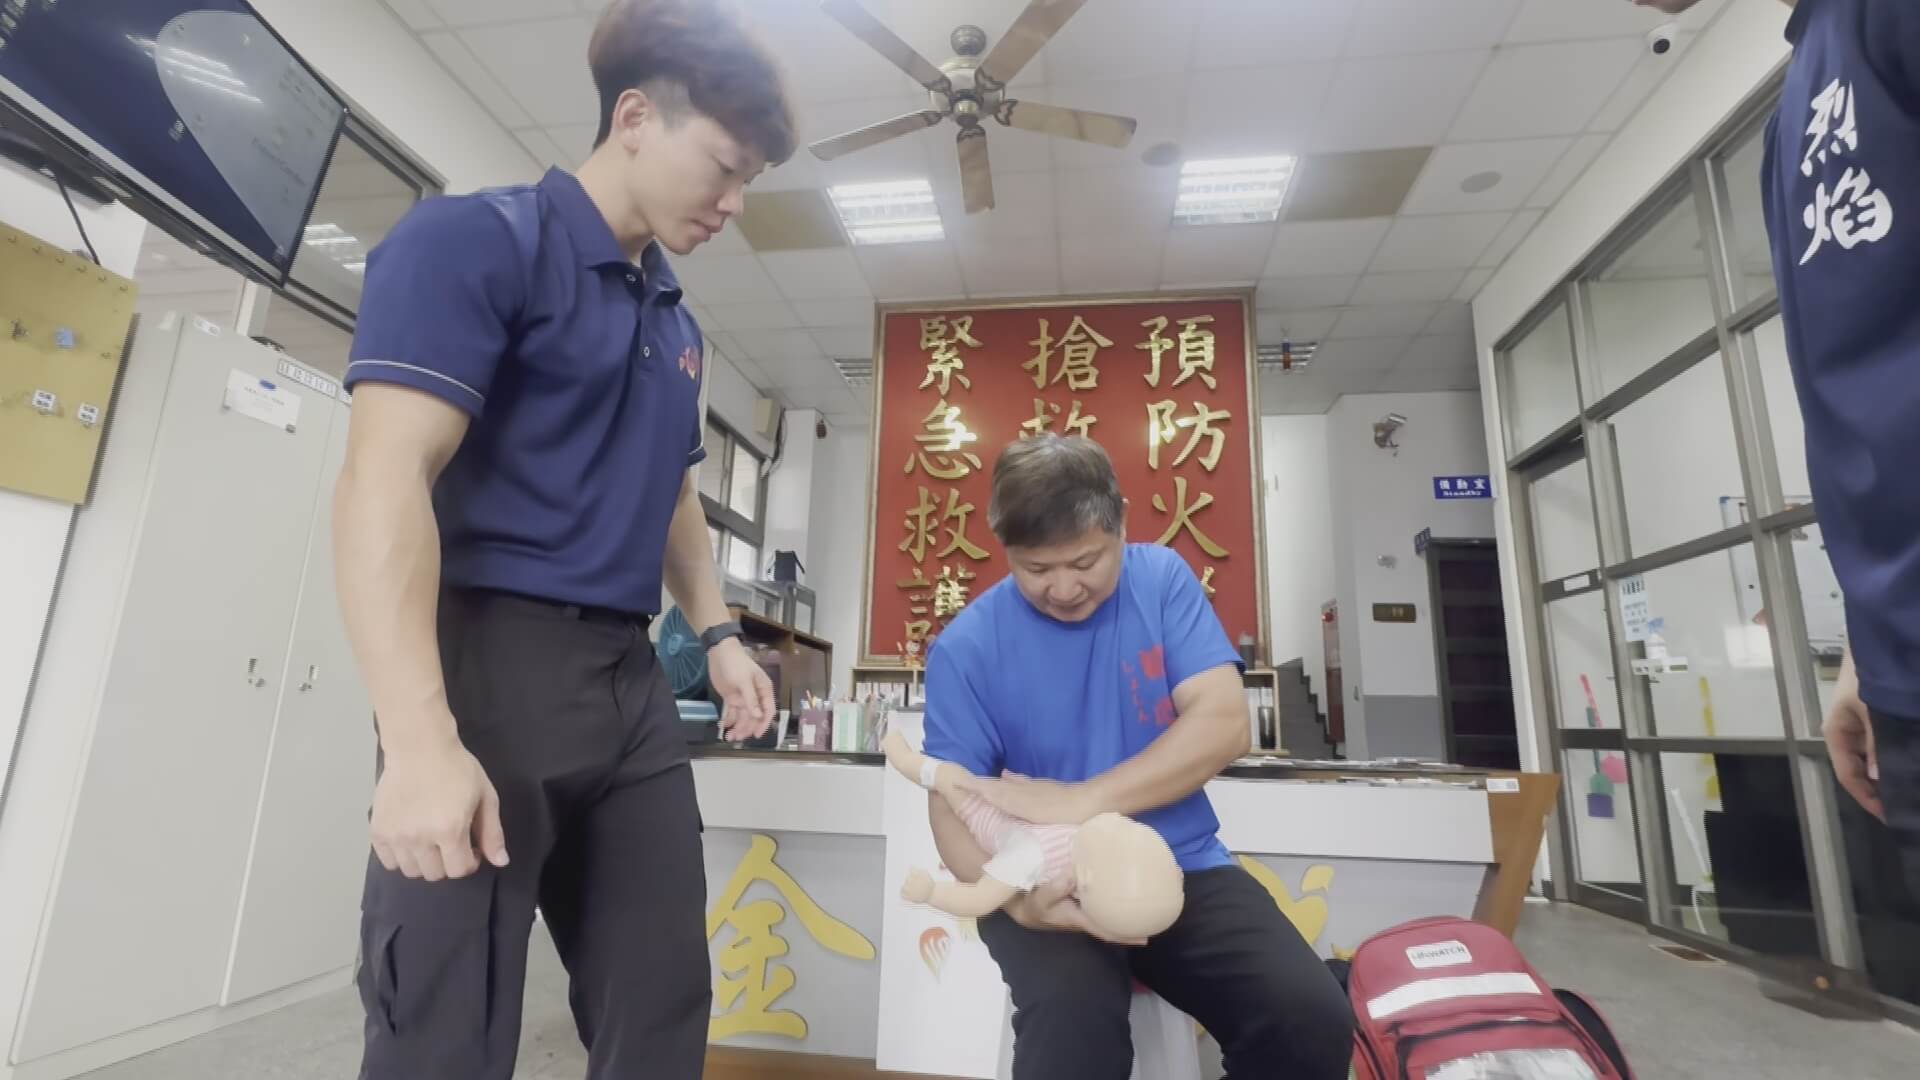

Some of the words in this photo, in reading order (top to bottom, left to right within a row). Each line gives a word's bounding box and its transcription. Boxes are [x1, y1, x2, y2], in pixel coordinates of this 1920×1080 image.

[1800, 78, 1893, 266] 烈焰
[1135, 314, 1232, 598] 預防火
[707, 833, 877, 1041] 金
